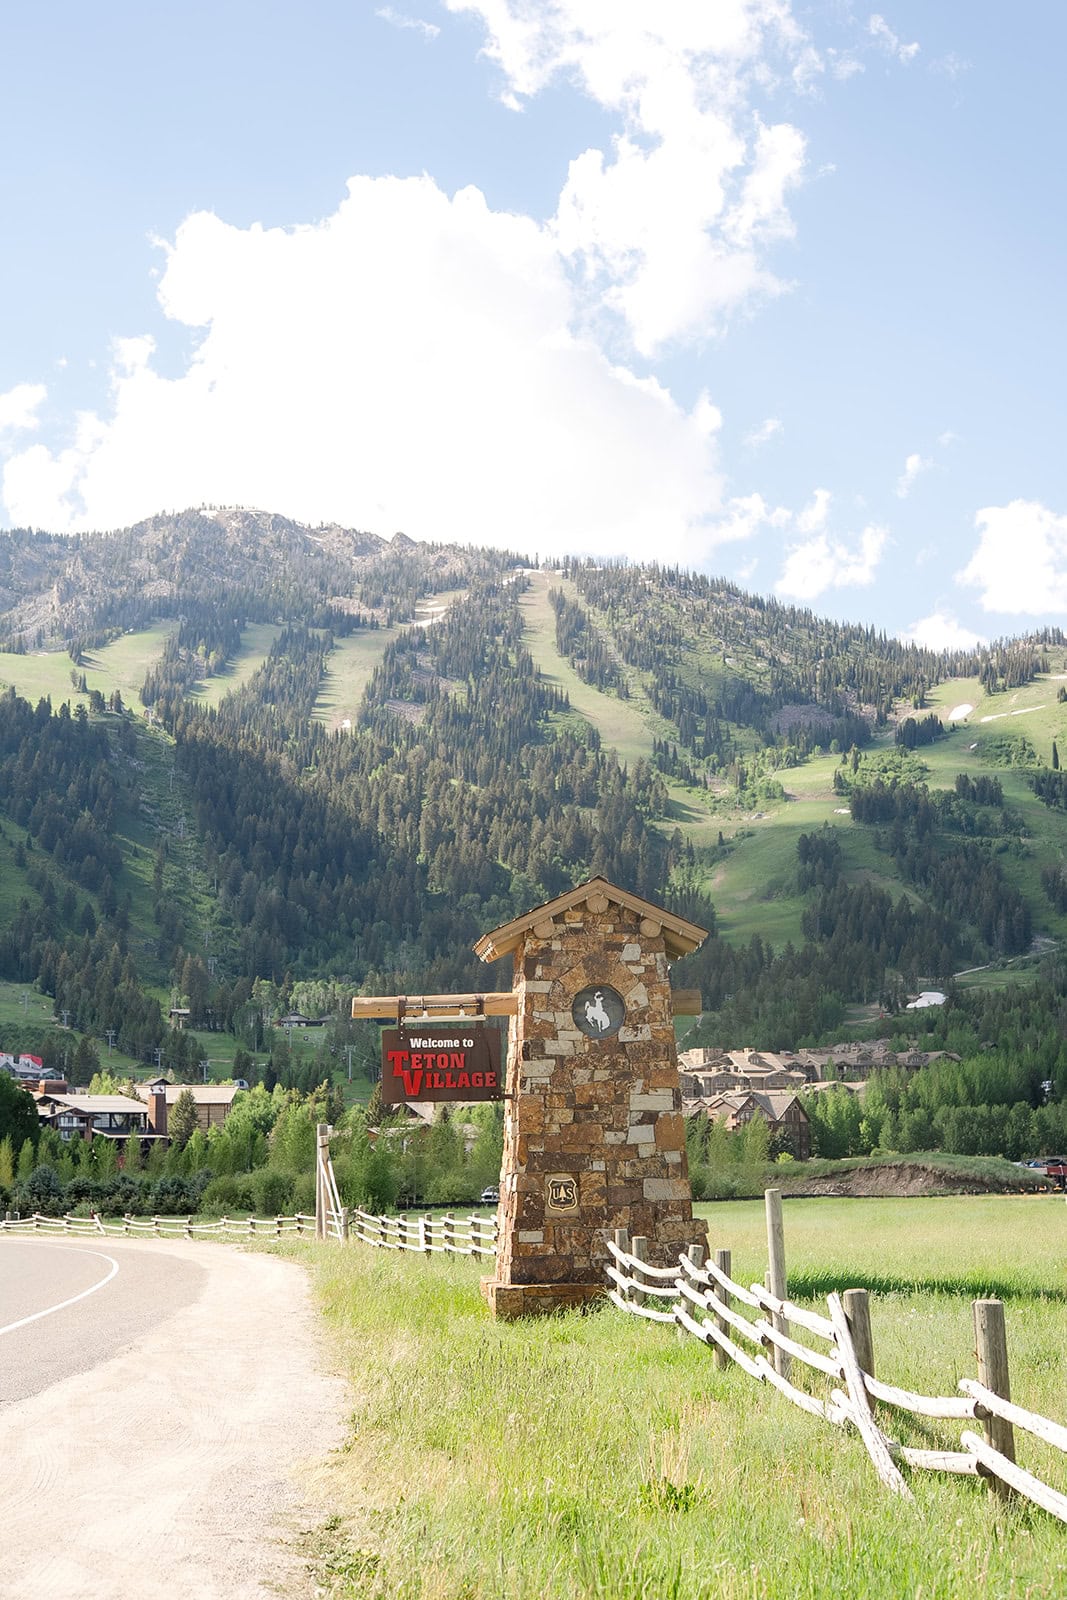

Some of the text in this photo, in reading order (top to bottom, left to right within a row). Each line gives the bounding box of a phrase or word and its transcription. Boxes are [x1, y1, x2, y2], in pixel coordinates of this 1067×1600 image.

[410, 1038, 474, 1048] Welcome to
[387, 1051, 465, 1076] TETON
[402, 1070, 497, 1096] VILLAGE
